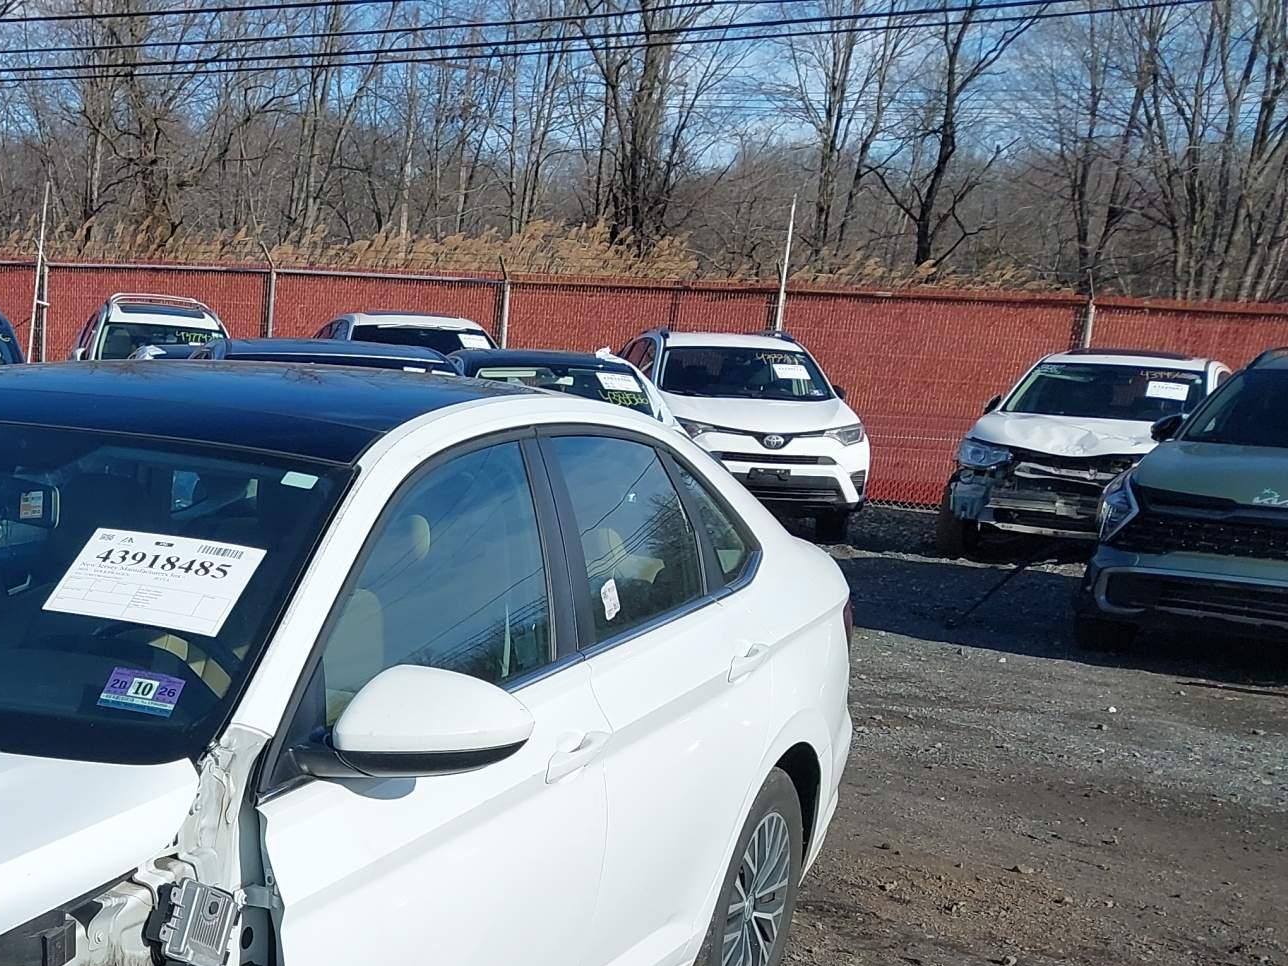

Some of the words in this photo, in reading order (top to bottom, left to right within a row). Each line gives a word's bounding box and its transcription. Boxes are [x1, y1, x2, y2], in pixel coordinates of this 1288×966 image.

[96, 548, 232, 579] 43918485
[111, 679, 128, 690] 20
[132, 681, 154, 697] 10
[158, 686, 177, 698] 26
